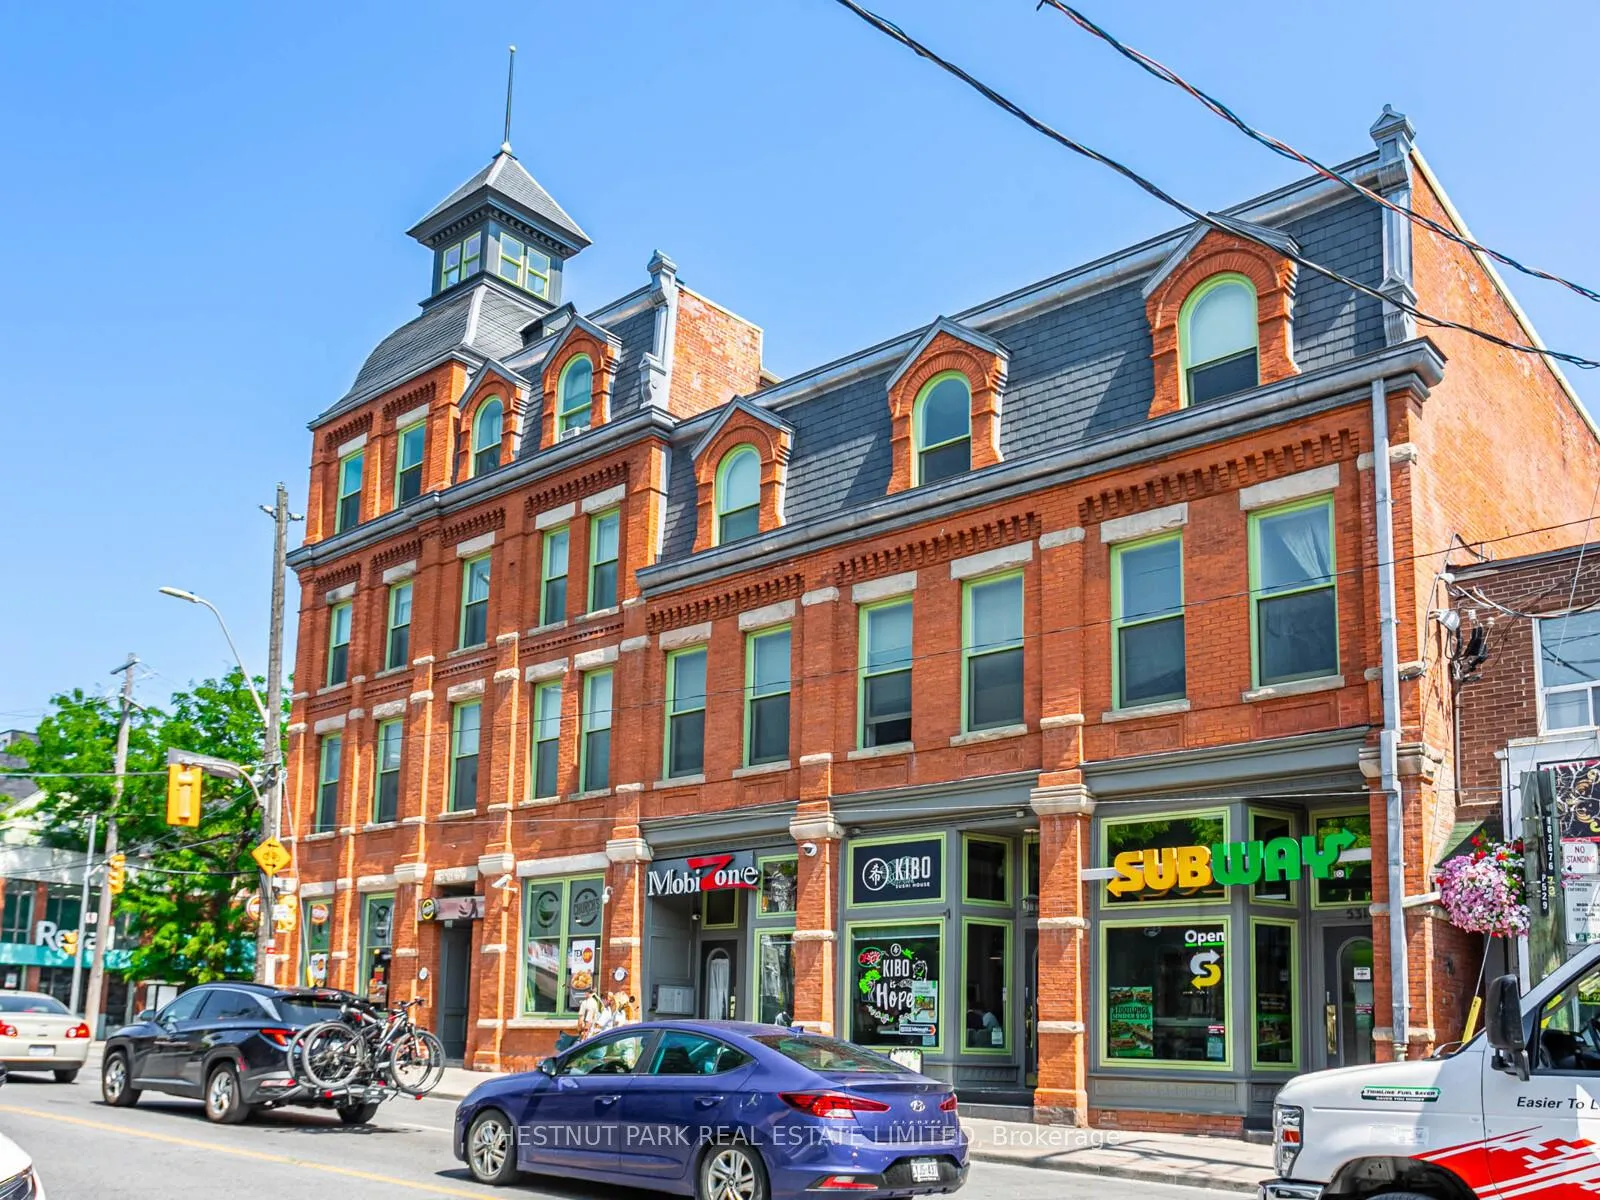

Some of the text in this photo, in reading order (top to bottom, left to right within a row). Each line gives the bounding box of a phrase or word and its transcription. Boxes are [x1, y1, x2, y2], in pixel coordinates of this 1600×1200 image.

[1574, 845, 1586, 854] NO
[1107, 829, 1357, 897] SUBWAY
[1566, 855, 1596, 864] STANDING
[895, 856, 931, 881] KIBO
[1185, 930, 1224, 945] Open
[882, 960, 910, 977] KIBO
[876, 983, 914, 1010] Hope
[1517, 1096, 1600, 1110] Easier To L
